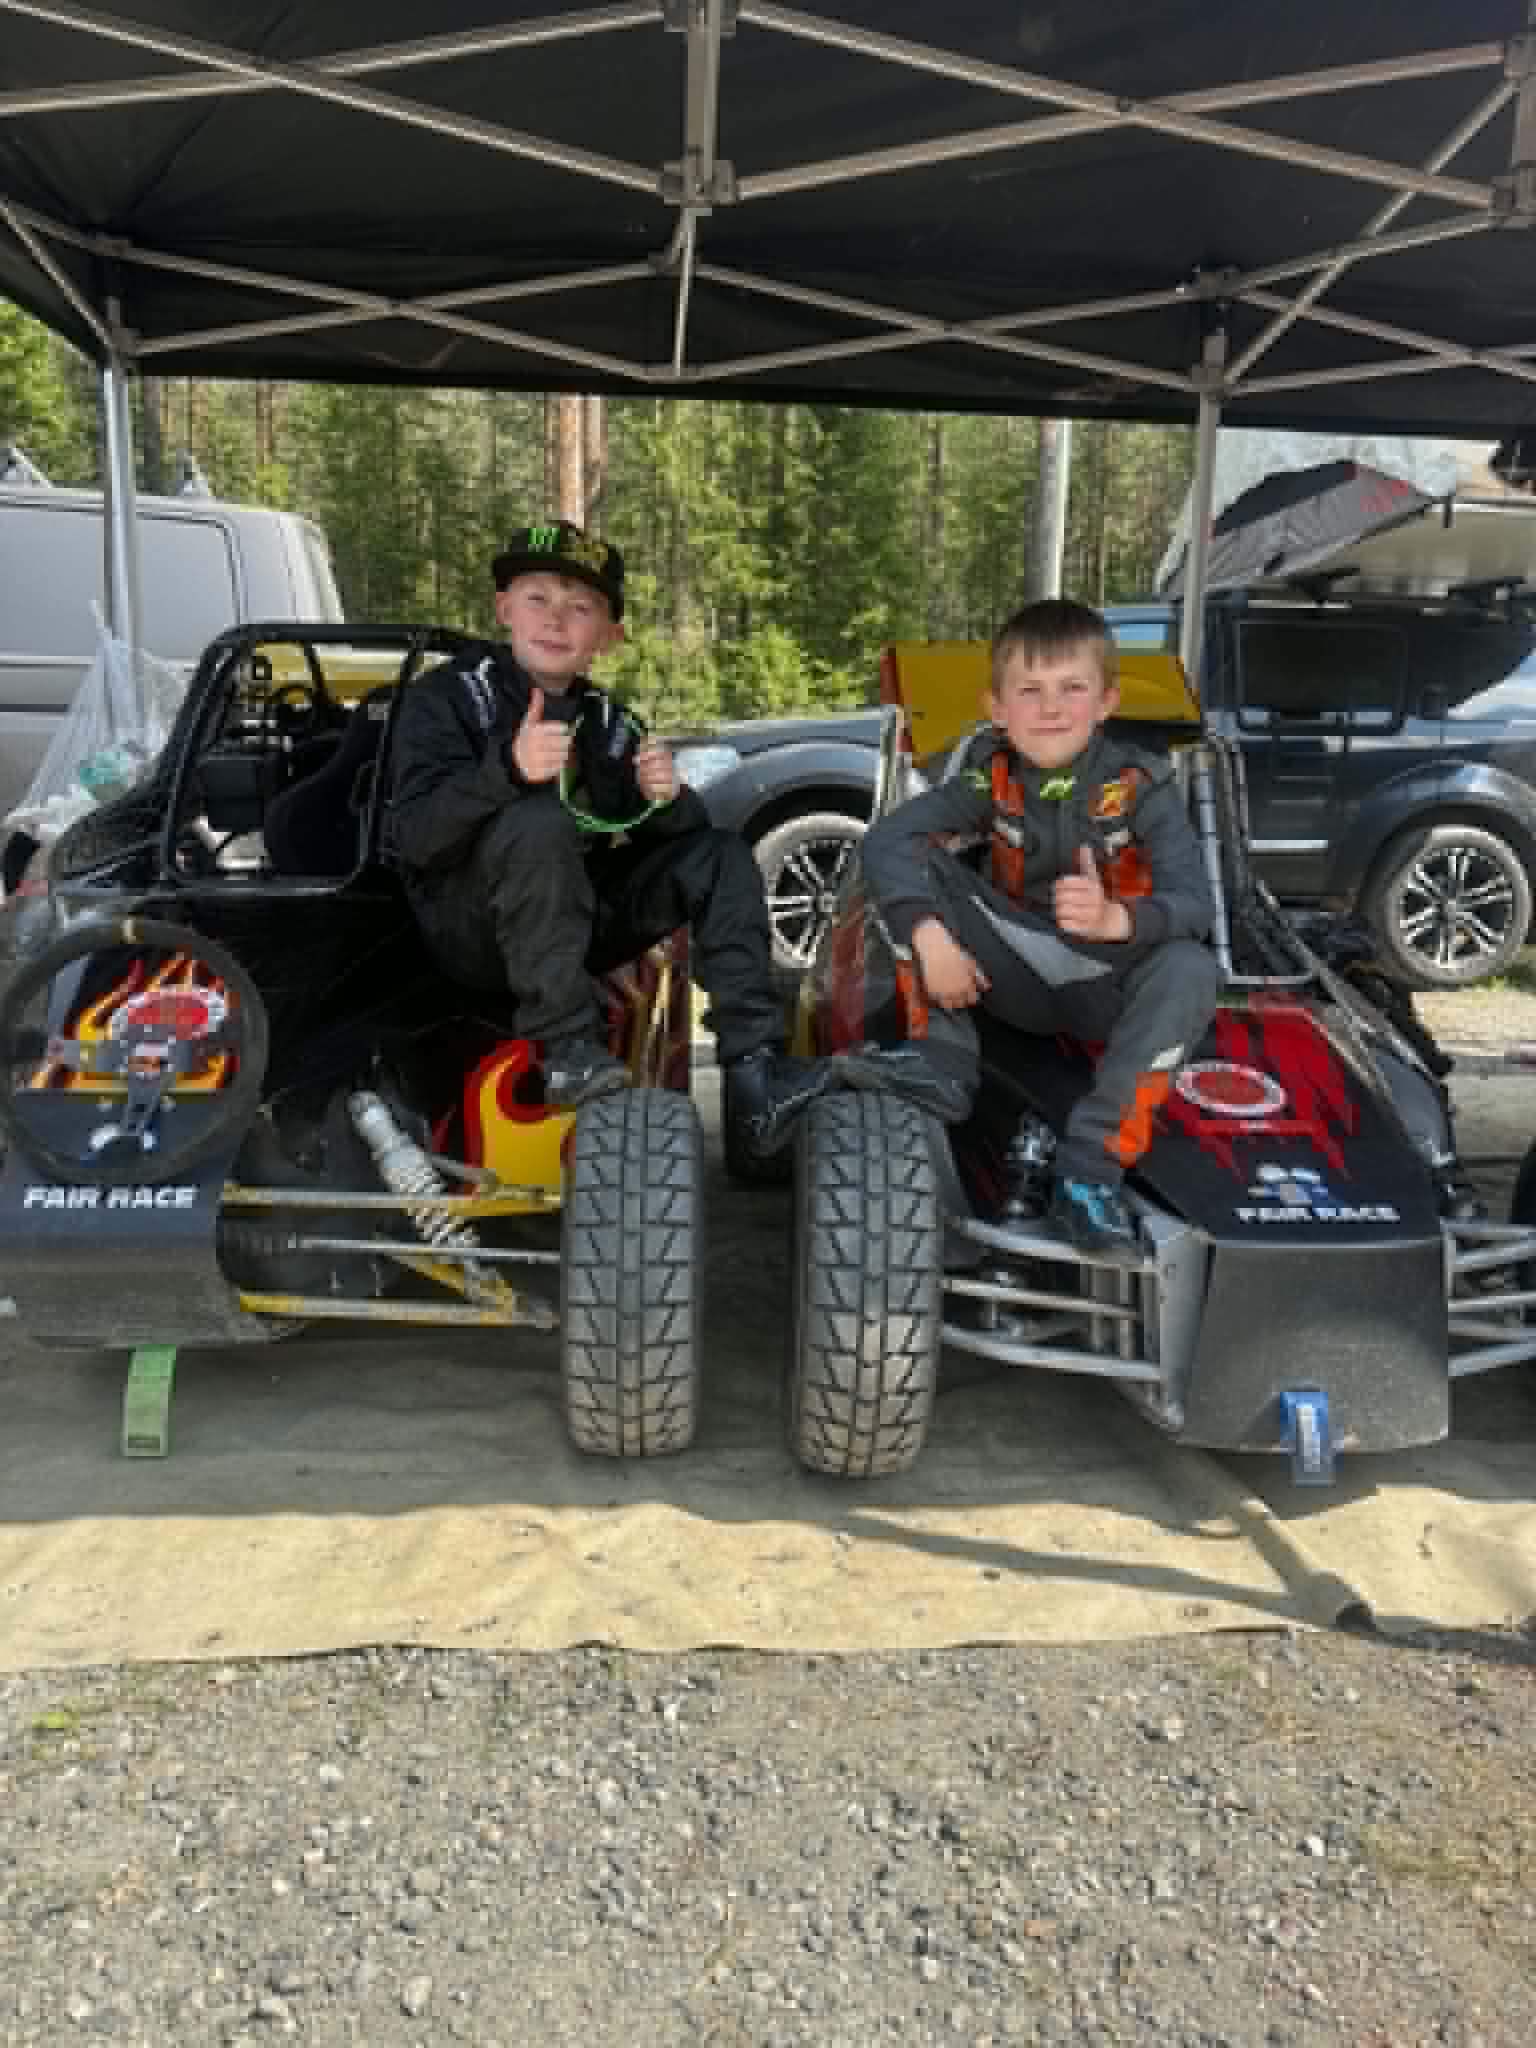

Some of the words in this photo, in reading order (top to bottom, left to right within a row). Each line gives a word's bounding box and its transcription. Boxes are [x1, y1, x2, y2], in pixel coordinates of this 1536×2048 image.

[23, 1186, 100, 1208] FAIR
[107, 1186, 197, 1208] RACE
[1235, 1206, 1311, 1222] FAIR
[1314, 1206, 1400, 1223] RACE
